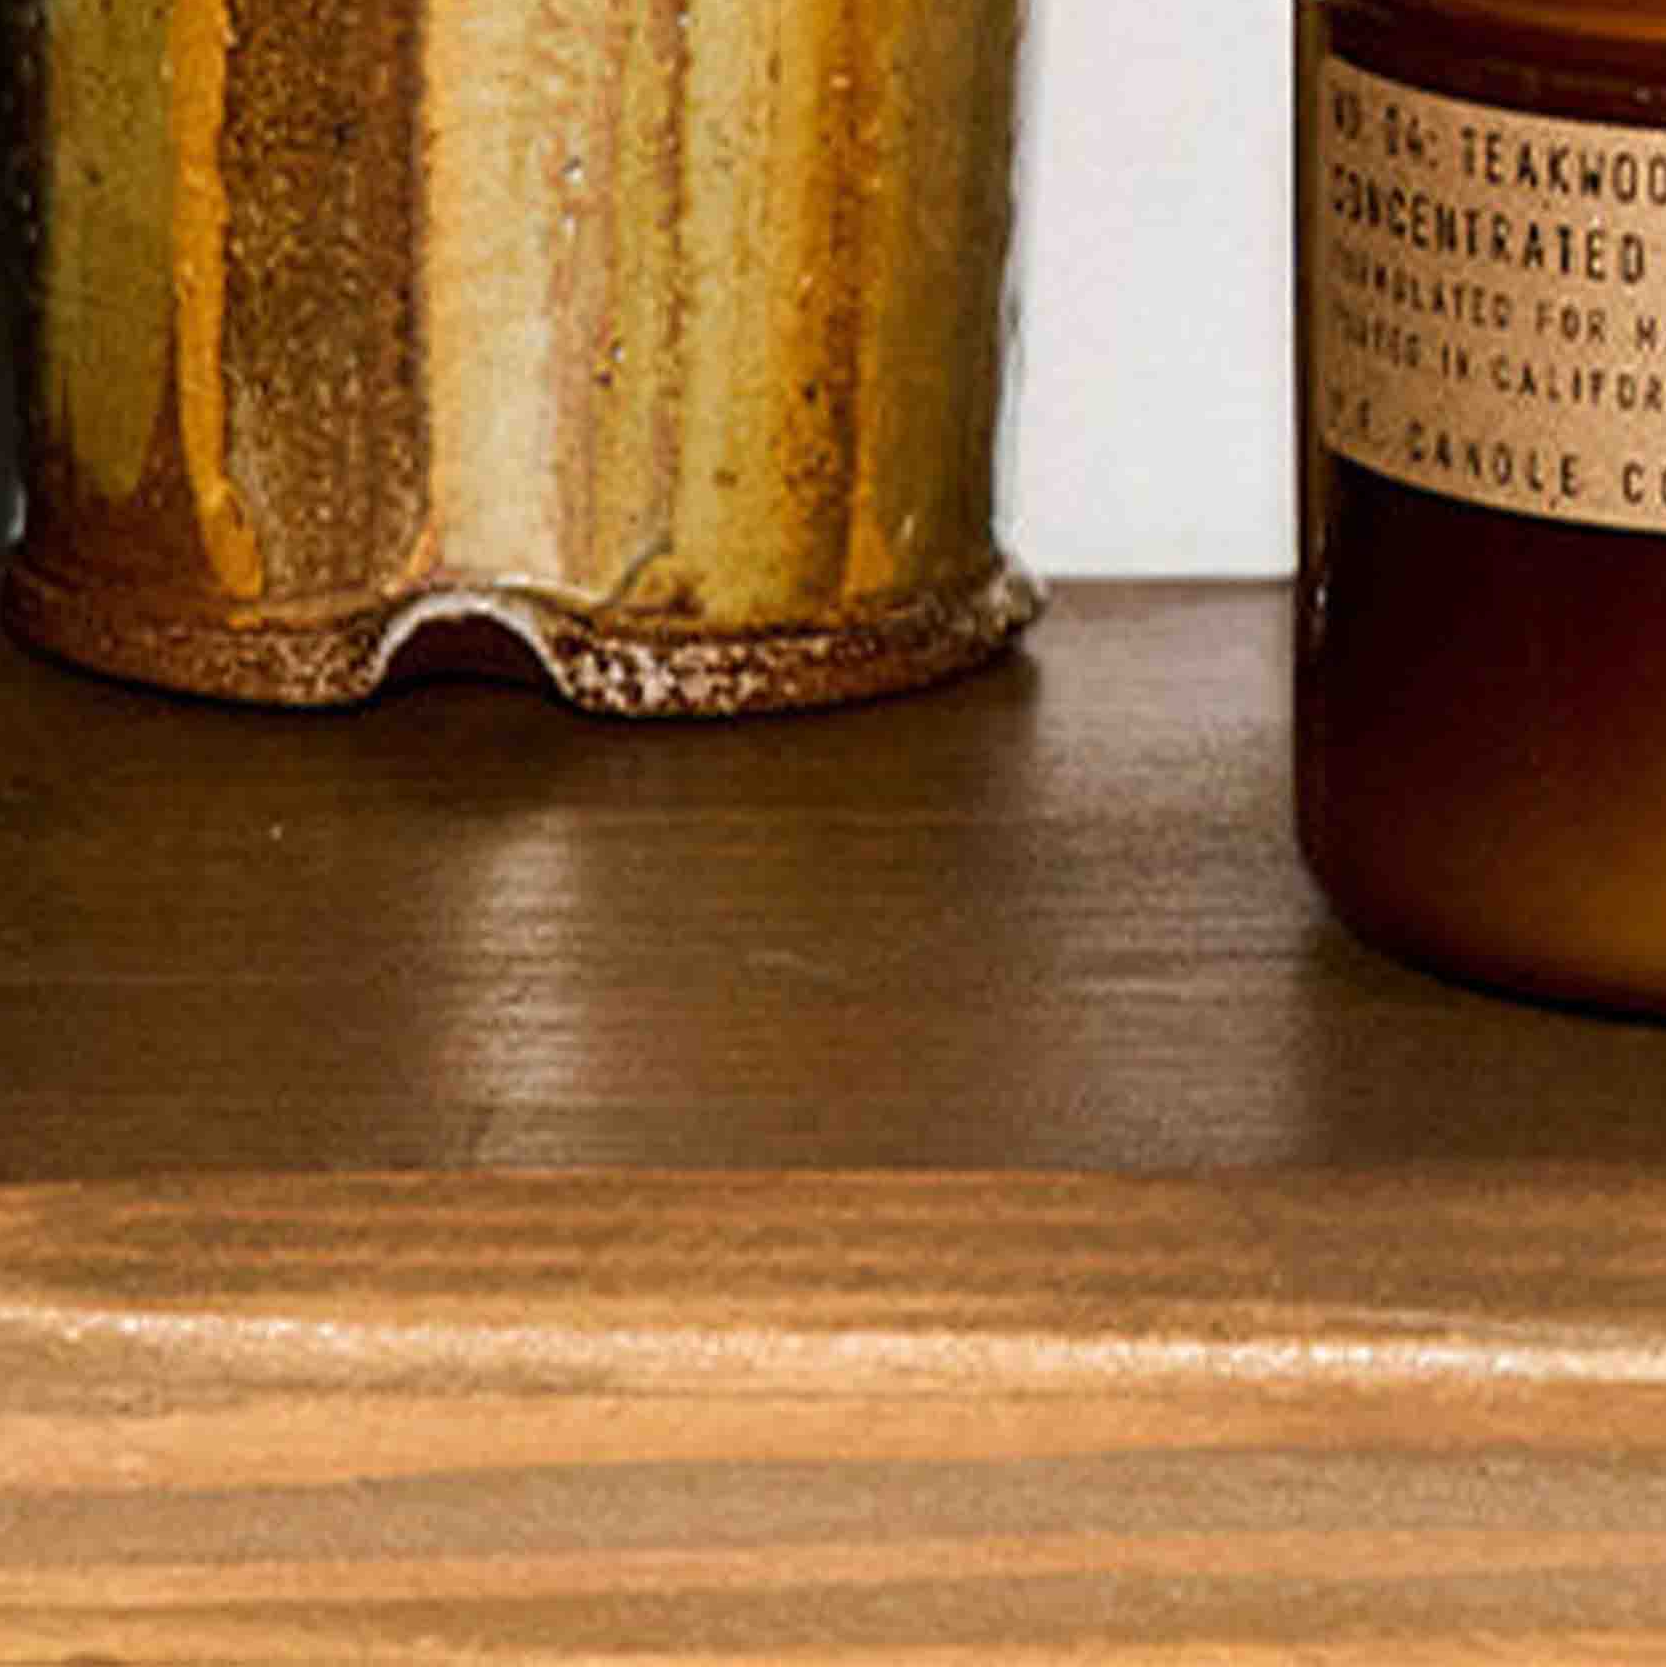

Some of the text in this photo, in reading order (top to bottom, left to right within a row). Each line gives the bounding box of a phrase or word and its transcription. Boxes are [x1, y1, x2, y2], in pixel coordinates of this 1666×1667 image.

[1333, 162, 1646, 285] CONCENTRATED
[1535, 300, 1606, 346] FOR
[1406, 418, 1581, 499] CANDLE
